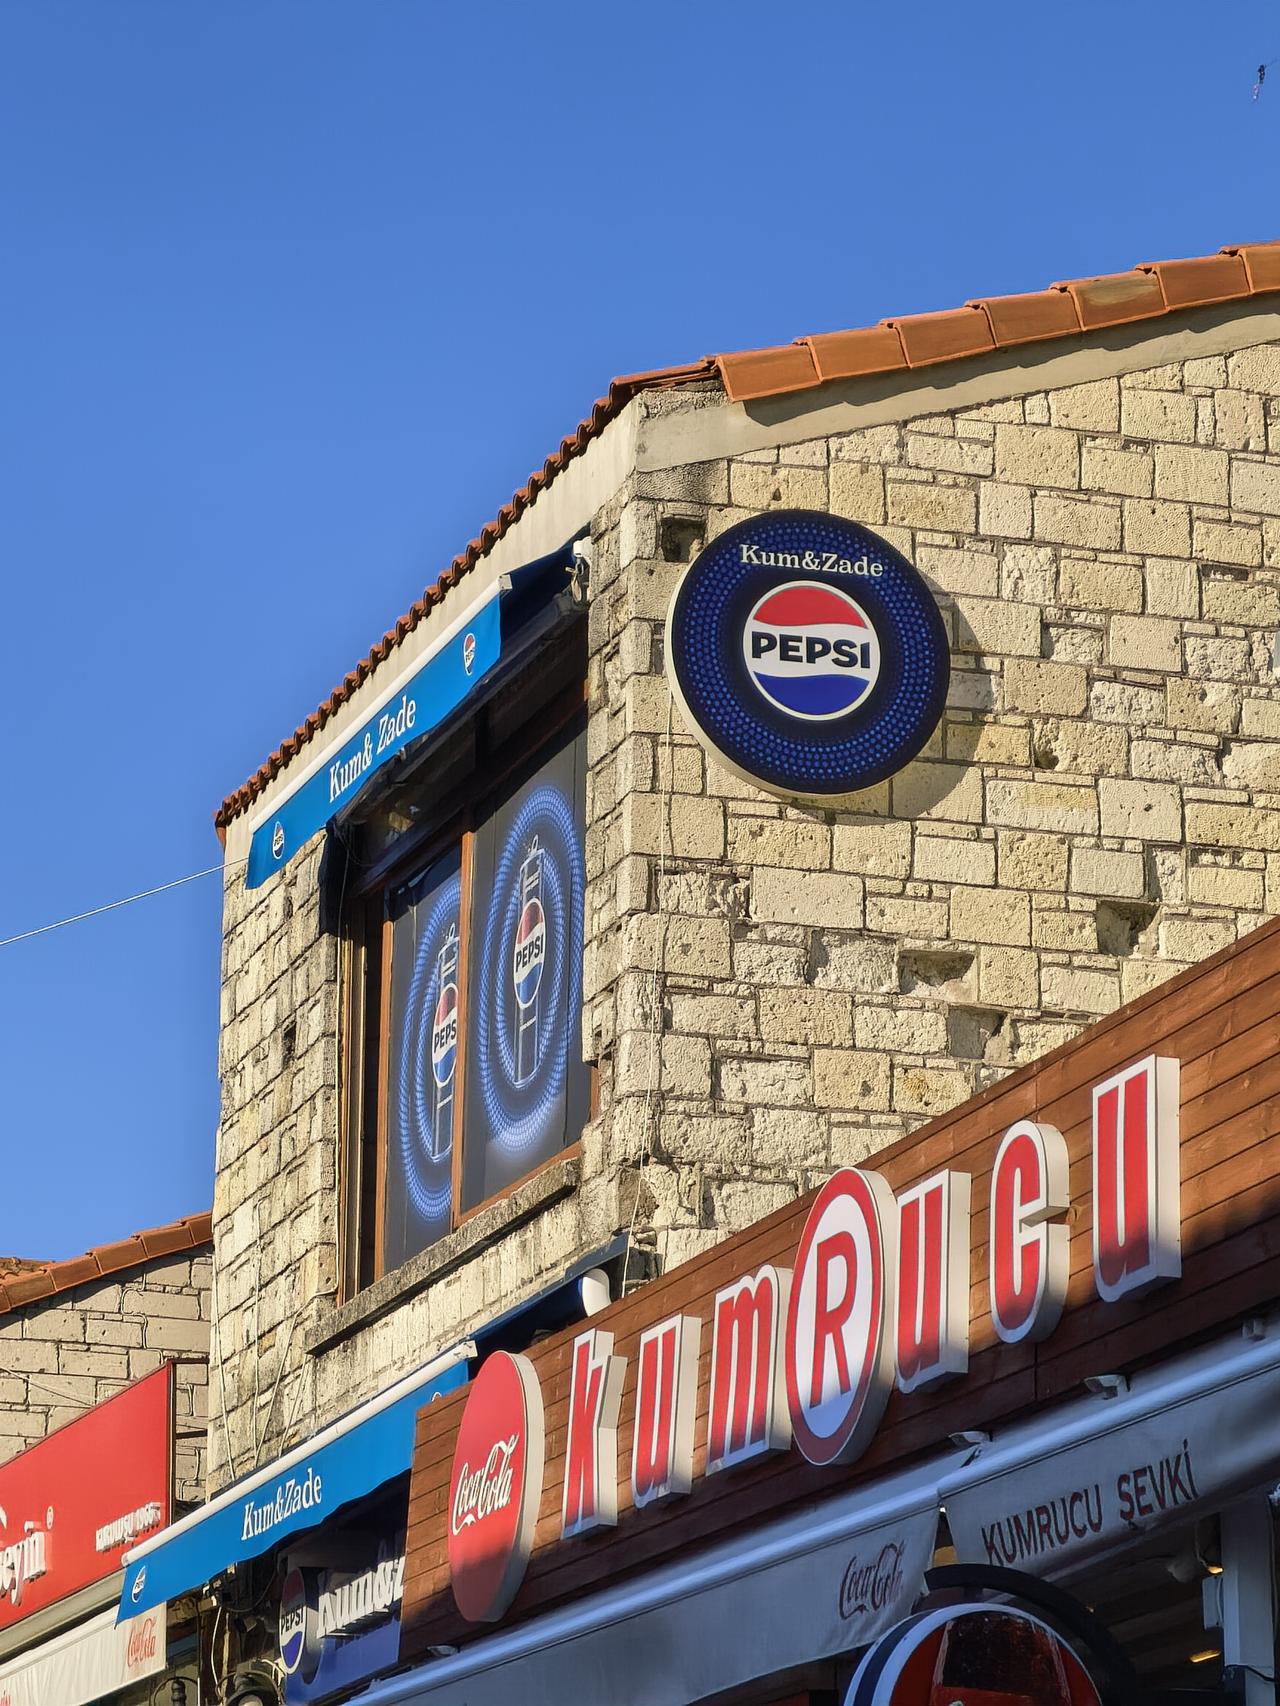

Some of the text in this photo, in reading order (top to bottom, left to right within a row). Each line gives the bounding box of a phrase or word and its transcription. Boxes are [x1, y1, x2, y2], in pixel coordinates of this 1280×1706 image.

[739, 544, 884, 577] Kum&Zade
[751, 631, 871, 669] PEPSI
[329, 695, 416, 803] Kum& Zade
[515, 933, 544, 973] PEPSI
[433, 1018, 456, 1054] PEPS
[241, 1467, 322, 1541] Kum&Zade
[452, 1432, 519, 1536] Coca-Cola
[981, 1438, 1199, 1567] KUMRUCU ŞEVKİ
[280, 1605, 305, 1634] PEPSI
